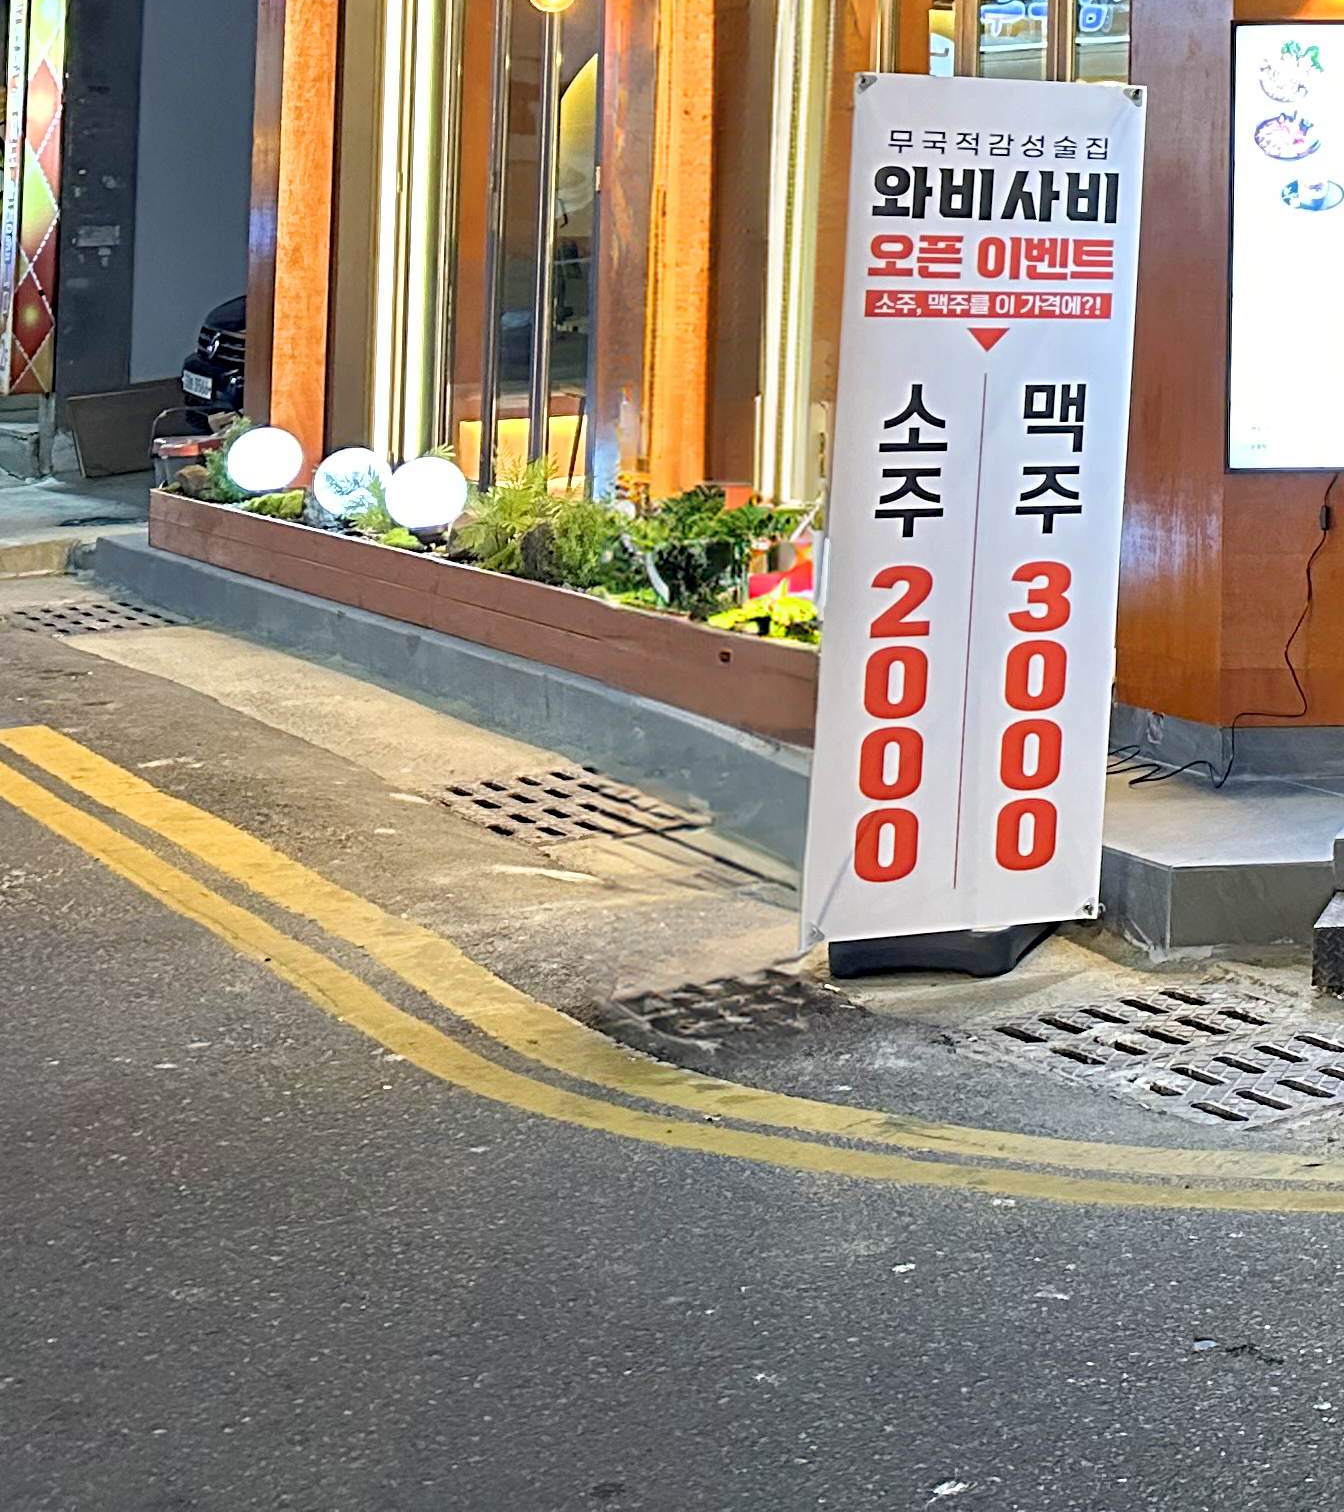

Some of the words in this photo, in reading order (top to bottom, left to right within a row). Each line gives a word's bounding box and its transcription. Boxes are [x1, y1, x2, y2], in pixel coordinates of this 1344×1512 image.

[871, 165, 1120, 225] 와비사비
[888, 129, 1110, 161] 무국적감성술집
[867, 234, 965, 280] 오픈
[976, 236, 1115, 281] 이벤트
[873, 293, 922, 317] 소주,
[927, 293, 990, 315] 맥주를
[995, 295, 1016, 315] 이
[1019, 295, 1102, 316] 가격에?!
[874, 383, 948, 538] 소주
[1015, 383, 1087, 534] 맥주
[853, 564, 934, 883] 2000
[995, 560, 1072, 871] 3000
